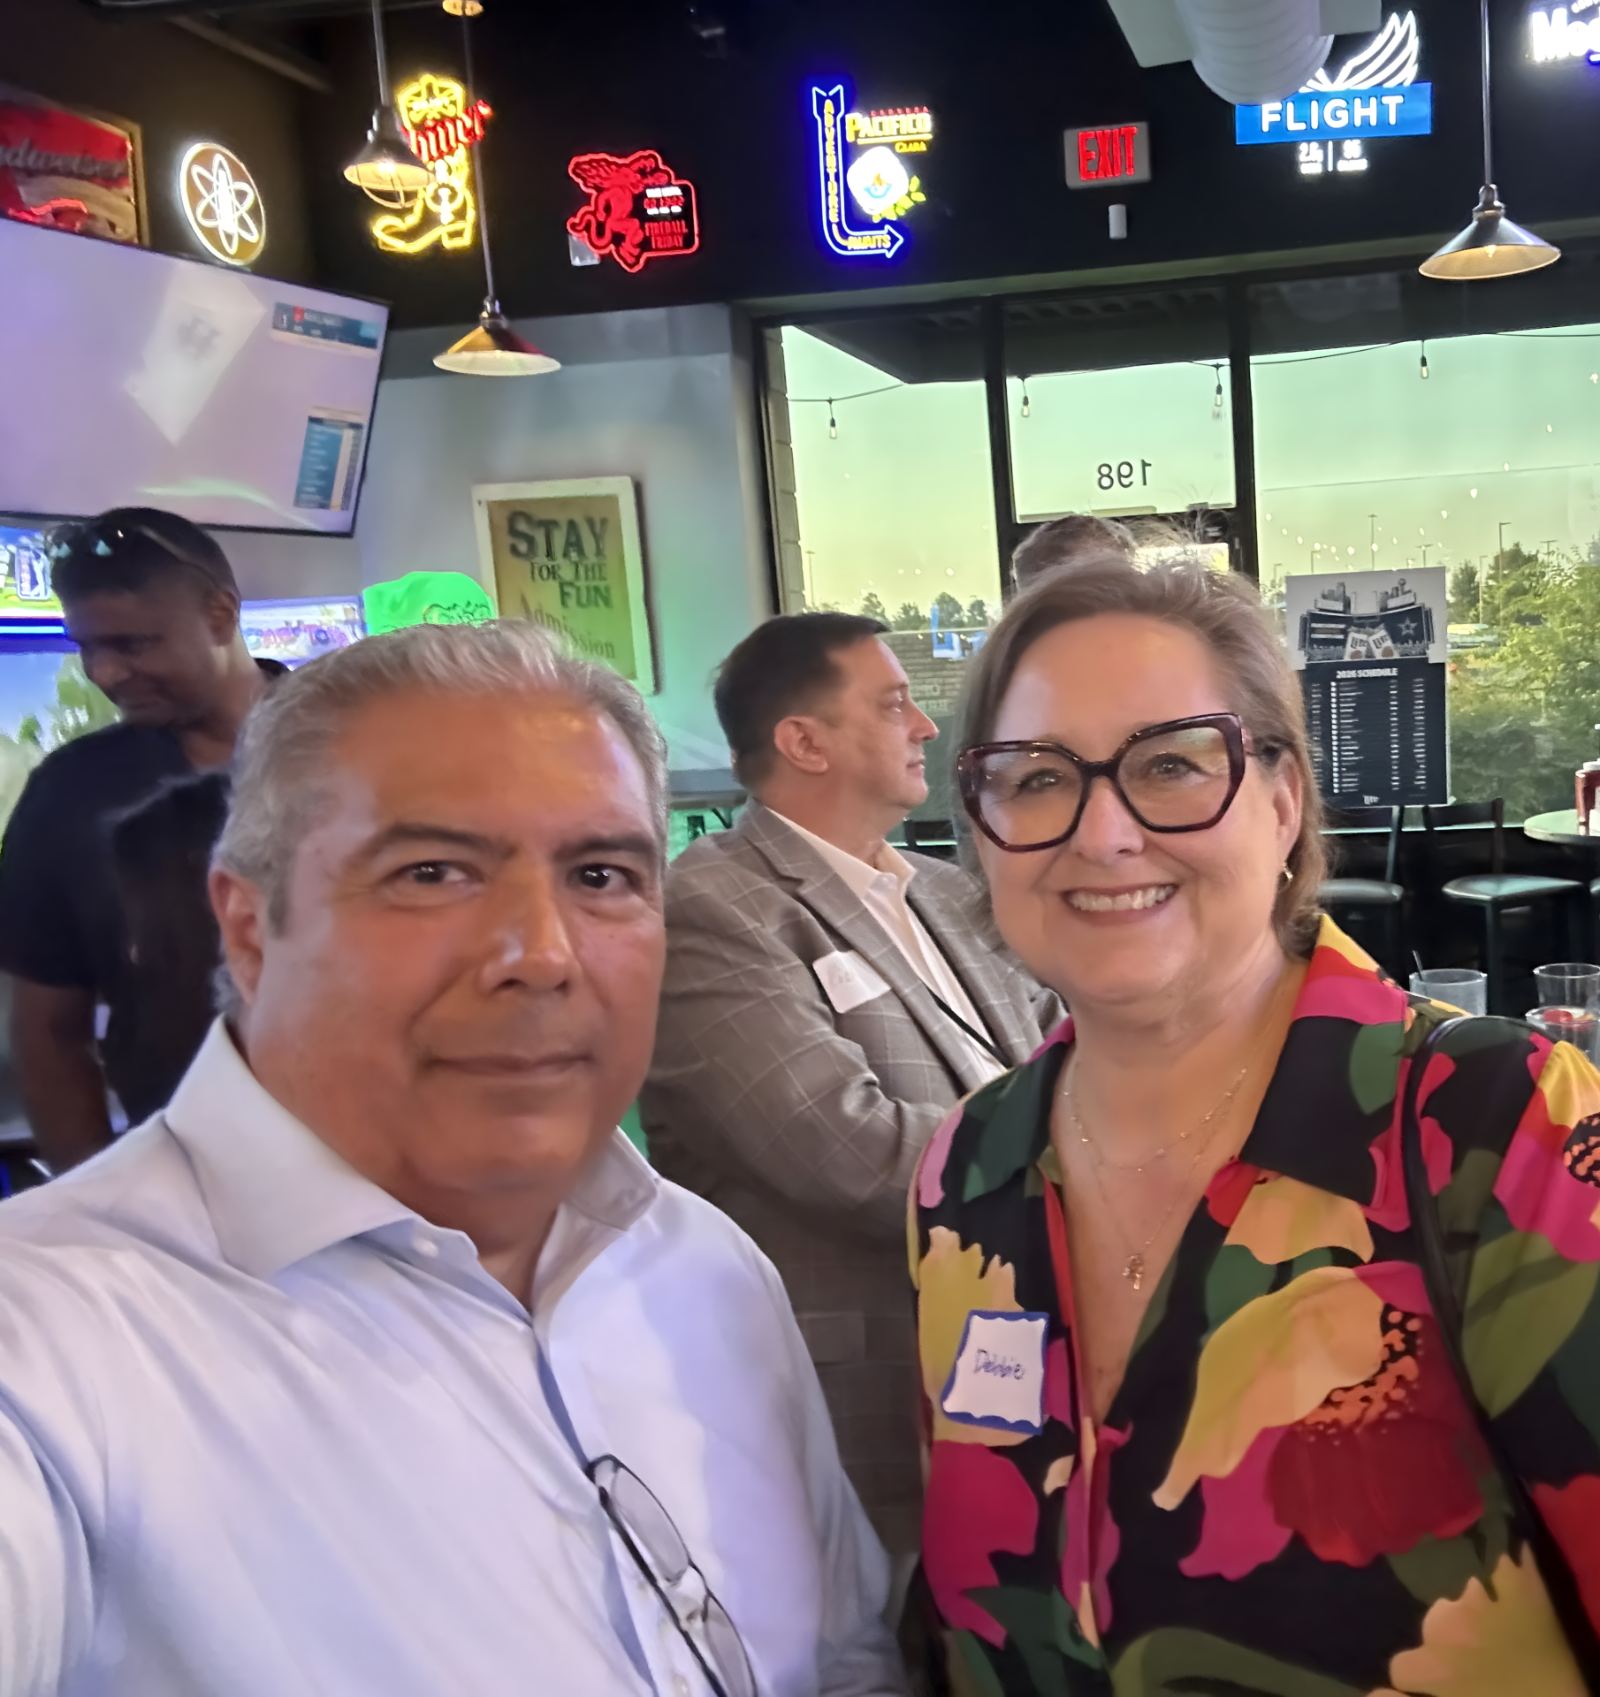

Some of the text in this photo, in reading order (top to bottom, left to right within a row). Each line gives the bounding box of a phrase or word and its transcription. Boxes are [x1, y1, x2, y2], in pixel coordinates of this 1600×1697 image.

[1261, 96, 1404, 132] FLIGHT
[1078, 126, 1138, 181] EXIT
[507, 510, 608, 561] STAY
[559, 580, 614, 609] FUN
